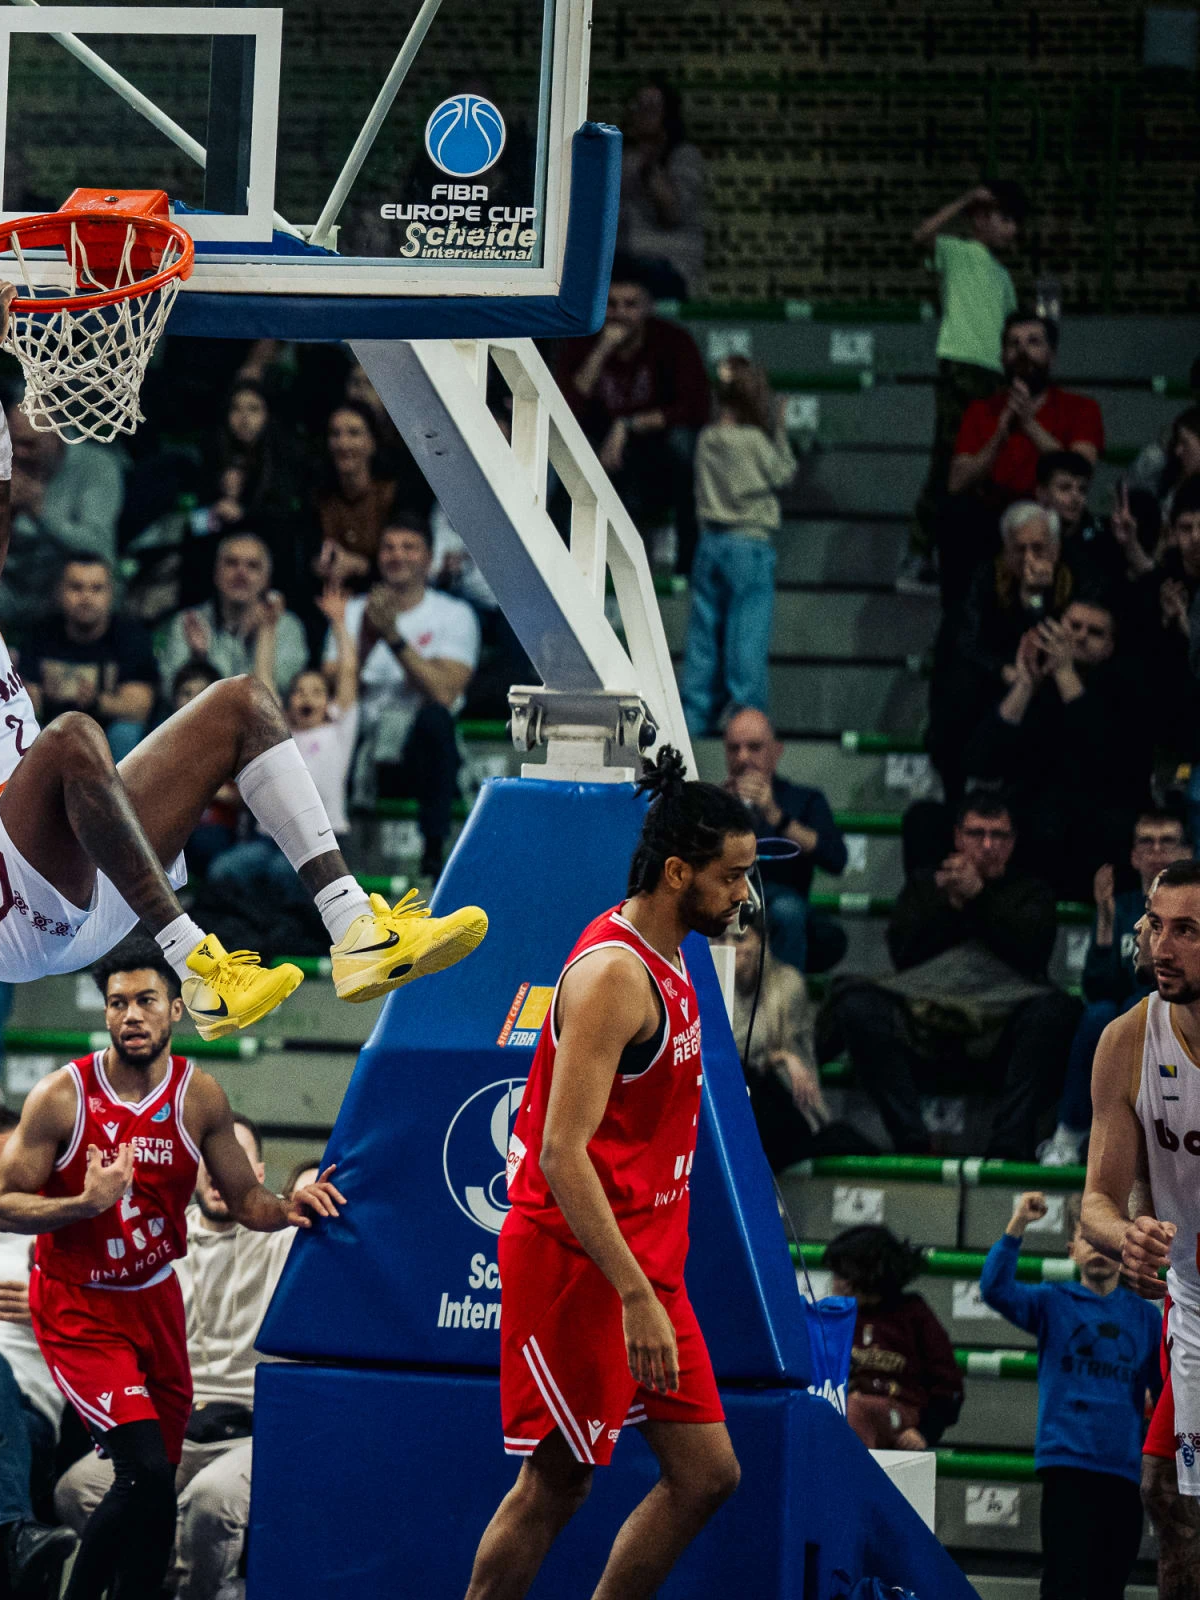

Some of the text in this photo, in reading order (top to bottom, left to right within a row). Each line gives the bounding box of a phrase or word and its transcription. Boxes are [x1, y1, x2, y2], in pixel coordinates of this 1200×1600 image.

[431, 184, 489, 201] FIBA
[380, 203, 538, 223] EUROPE CUP
[5, 714, 31, 757] 2
[507, 1031, 537, 1046] FIBA
